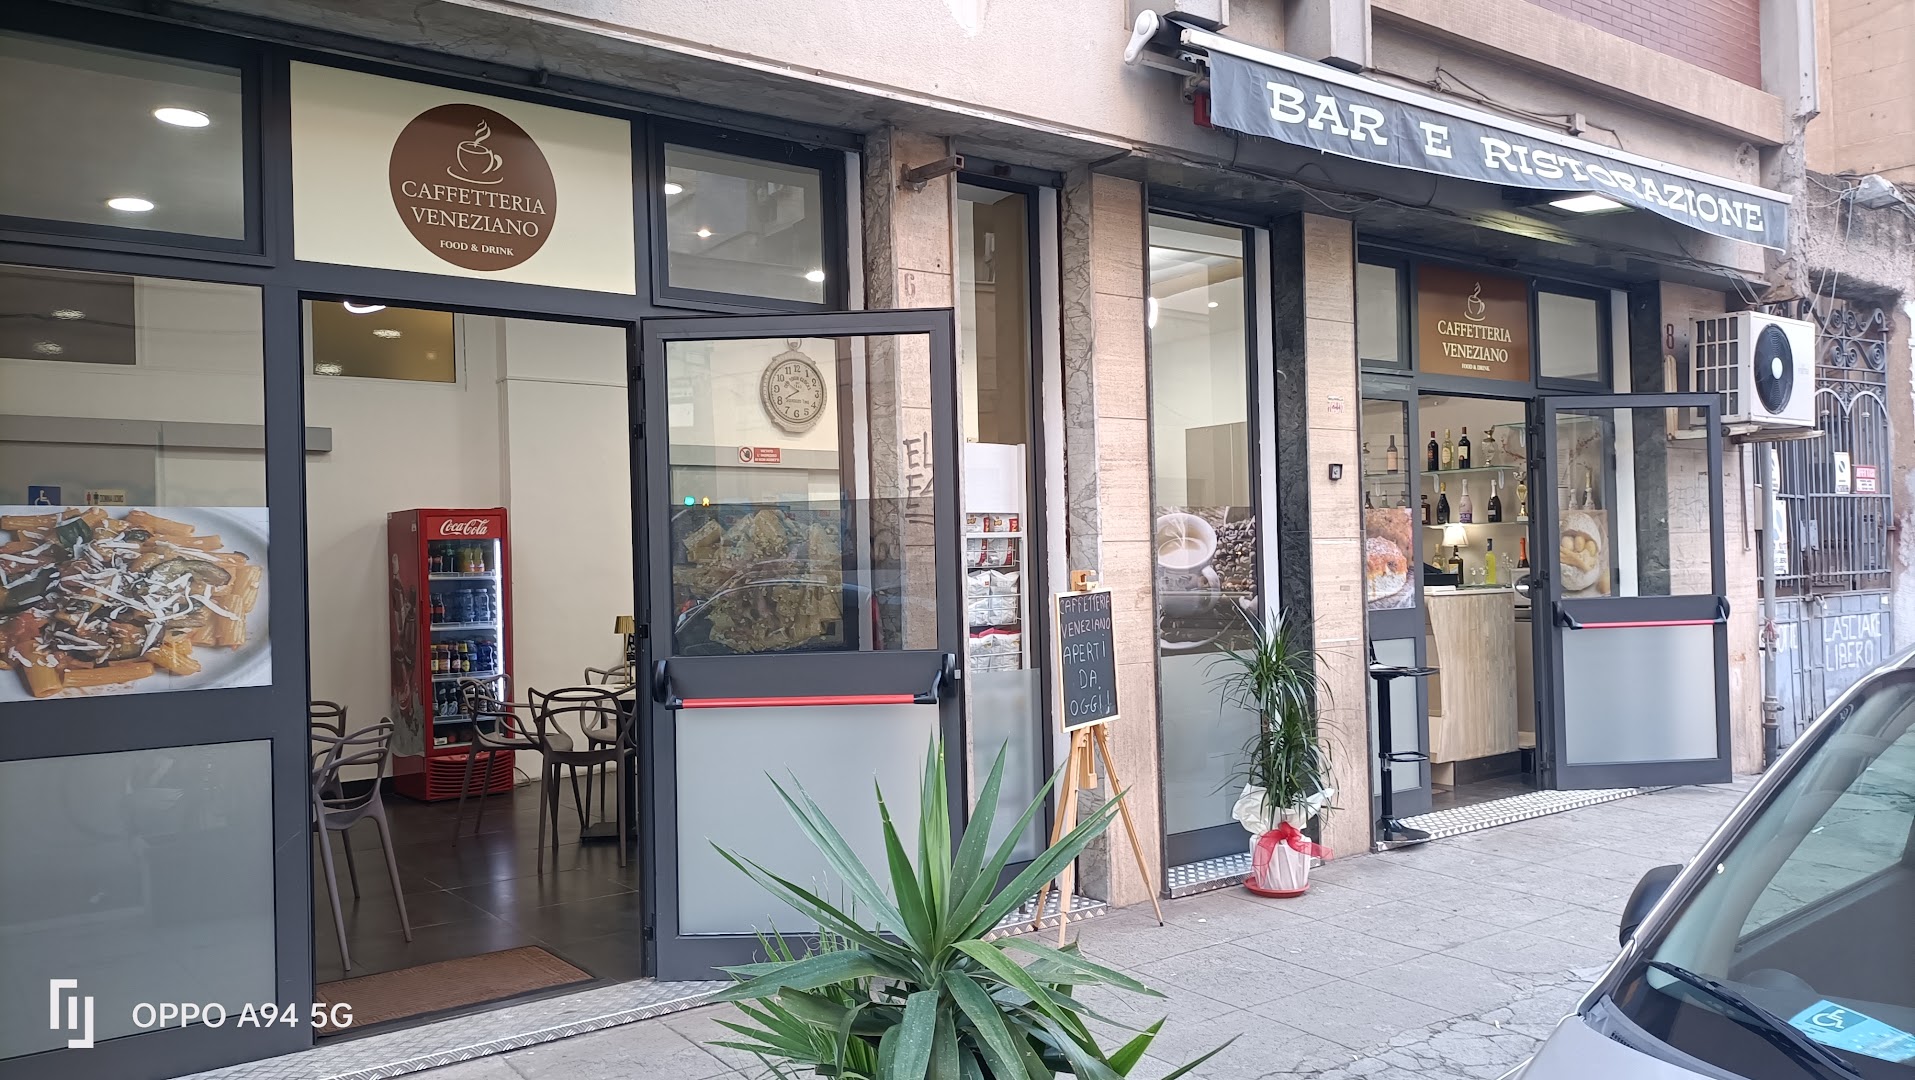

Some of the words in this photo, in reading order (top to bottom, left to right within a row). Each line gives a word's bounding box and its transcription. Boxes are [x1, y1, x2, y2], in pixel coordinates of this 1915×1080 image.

[1266, 81, 1388, 146] BAR
[1419, 121, 1452, 159] E
[1480, 136, 1765, 232] RISTORAZIONE
[401, 180, 546, 215] CAFFETTERIA
[410, 206, 539, 238] VENEZIANO
[440, 240, 469, 251] FOOD
[471, 243, 479, 252] &
[481, 245, 514, 257] DRINK
[904, 273, 915, 298] 6
[1437, 320, 1512, 343] CAFFETTERIA
[1666, 323, 1675, 350] 8
[1442, 342, 1508, 363] VENEZIANO
[785, 367, 792, 375] 11
[794, 365, 801, 373] 12
[805, 370, 810, 378] 1
[777, 374, 785, 383] 10
[812, 378, 817, 388] 2
[774, 385, 781, 394] 9
[815, 390, 820, 399] 3
[777, 396, 783, 406] 8
[785, 406, 791, 415] 7
[794, 410, 800, 418] 6
[804, 408, 810, 416] 5
[440, 519, 490, 535] Coca-Cola
[1061, 617, 1110, 639] VENEZIANO
[1823, 613, 1881, 642] LASCIARE
[1063, 634, 1106, 664] APERTI
[1825, 640, 1874, 672] LIBERO
[1079, 669, 1097, 689] DA
